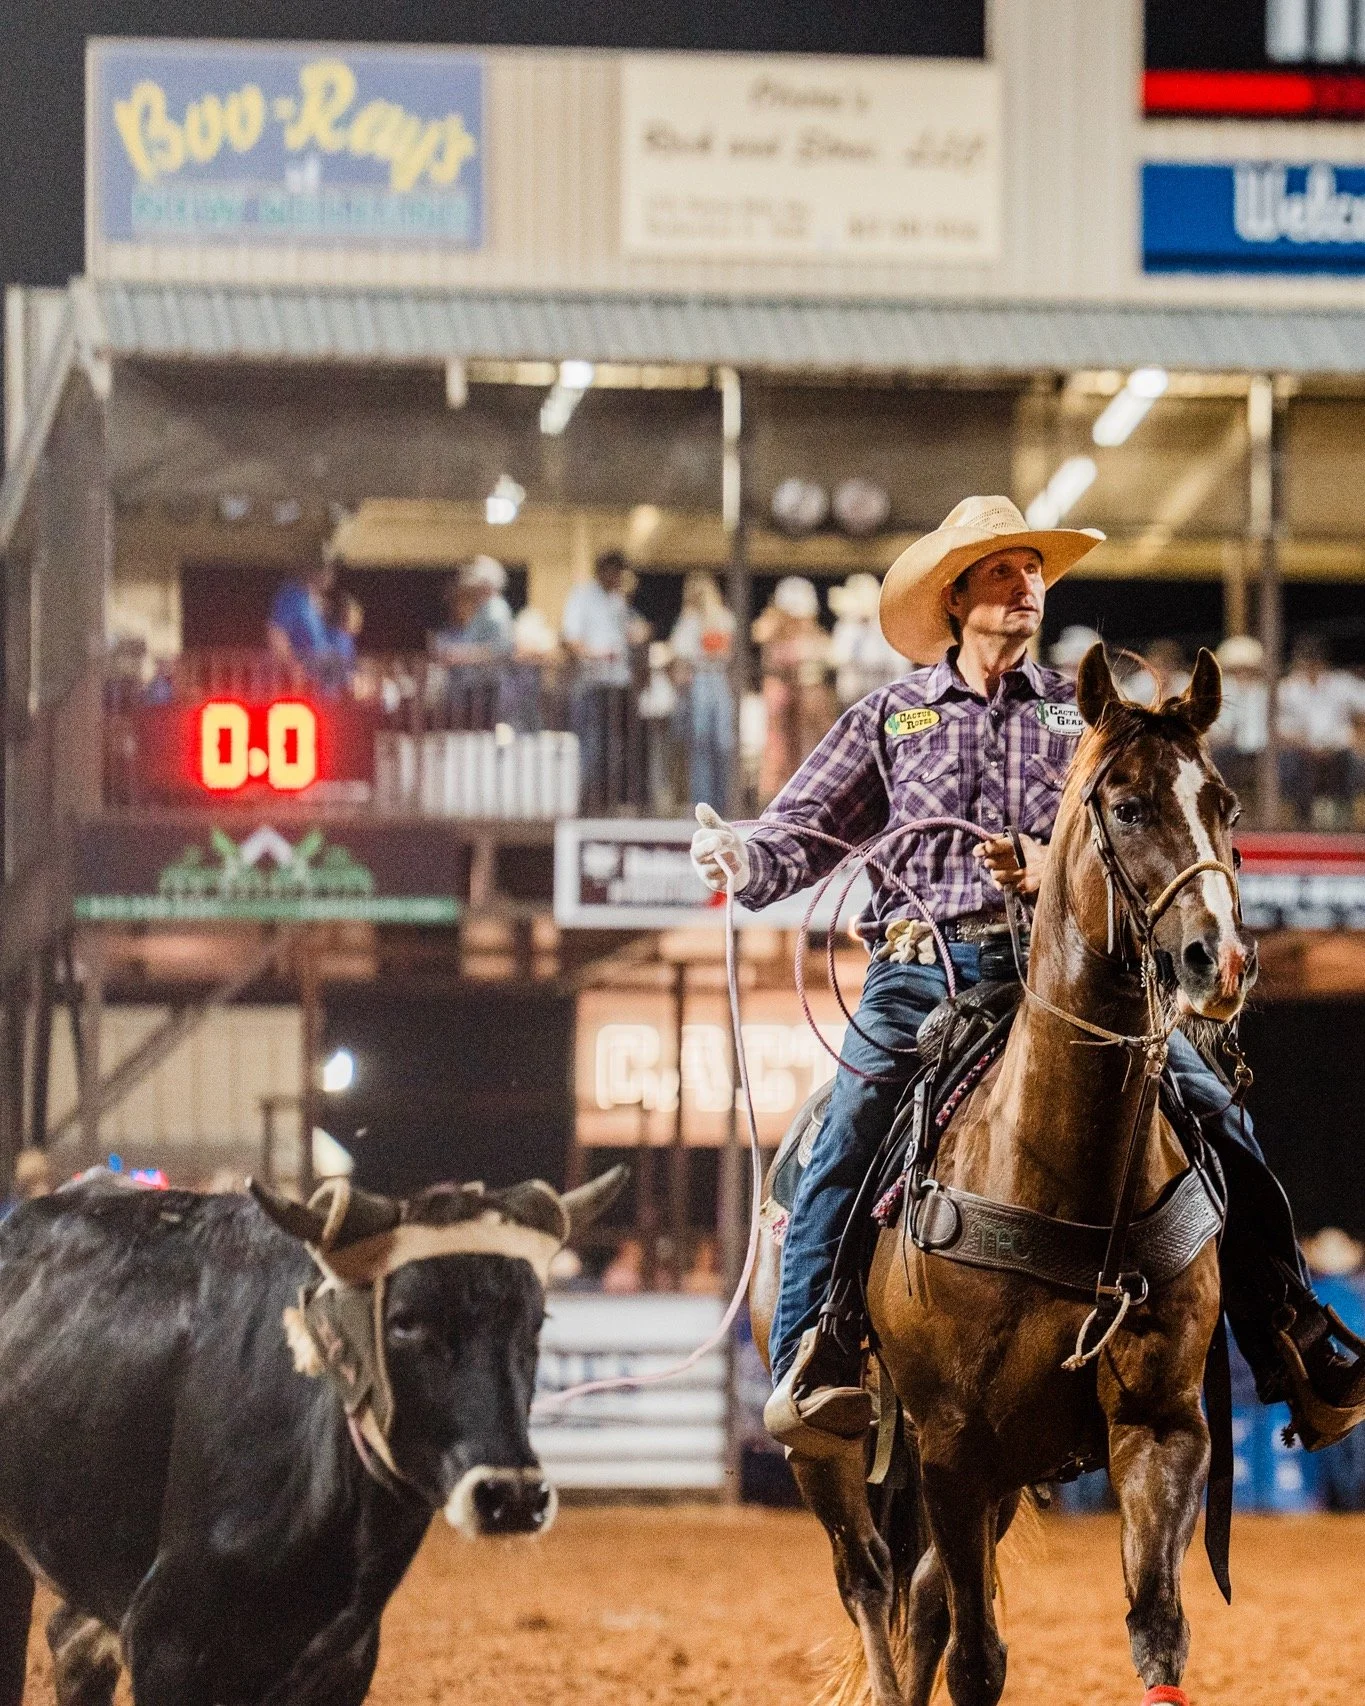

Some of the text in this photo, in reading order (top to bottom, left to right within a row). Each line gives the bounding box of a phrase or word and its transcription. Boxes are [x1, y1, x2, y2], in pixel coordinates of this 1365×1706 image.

[899, 710, 932, 723] CACTUS
[1049, 705, 1083, 717] CACTU
[906, 718, 933, 730] ROPES
[1057, 715, 1084, 726] GEAR
